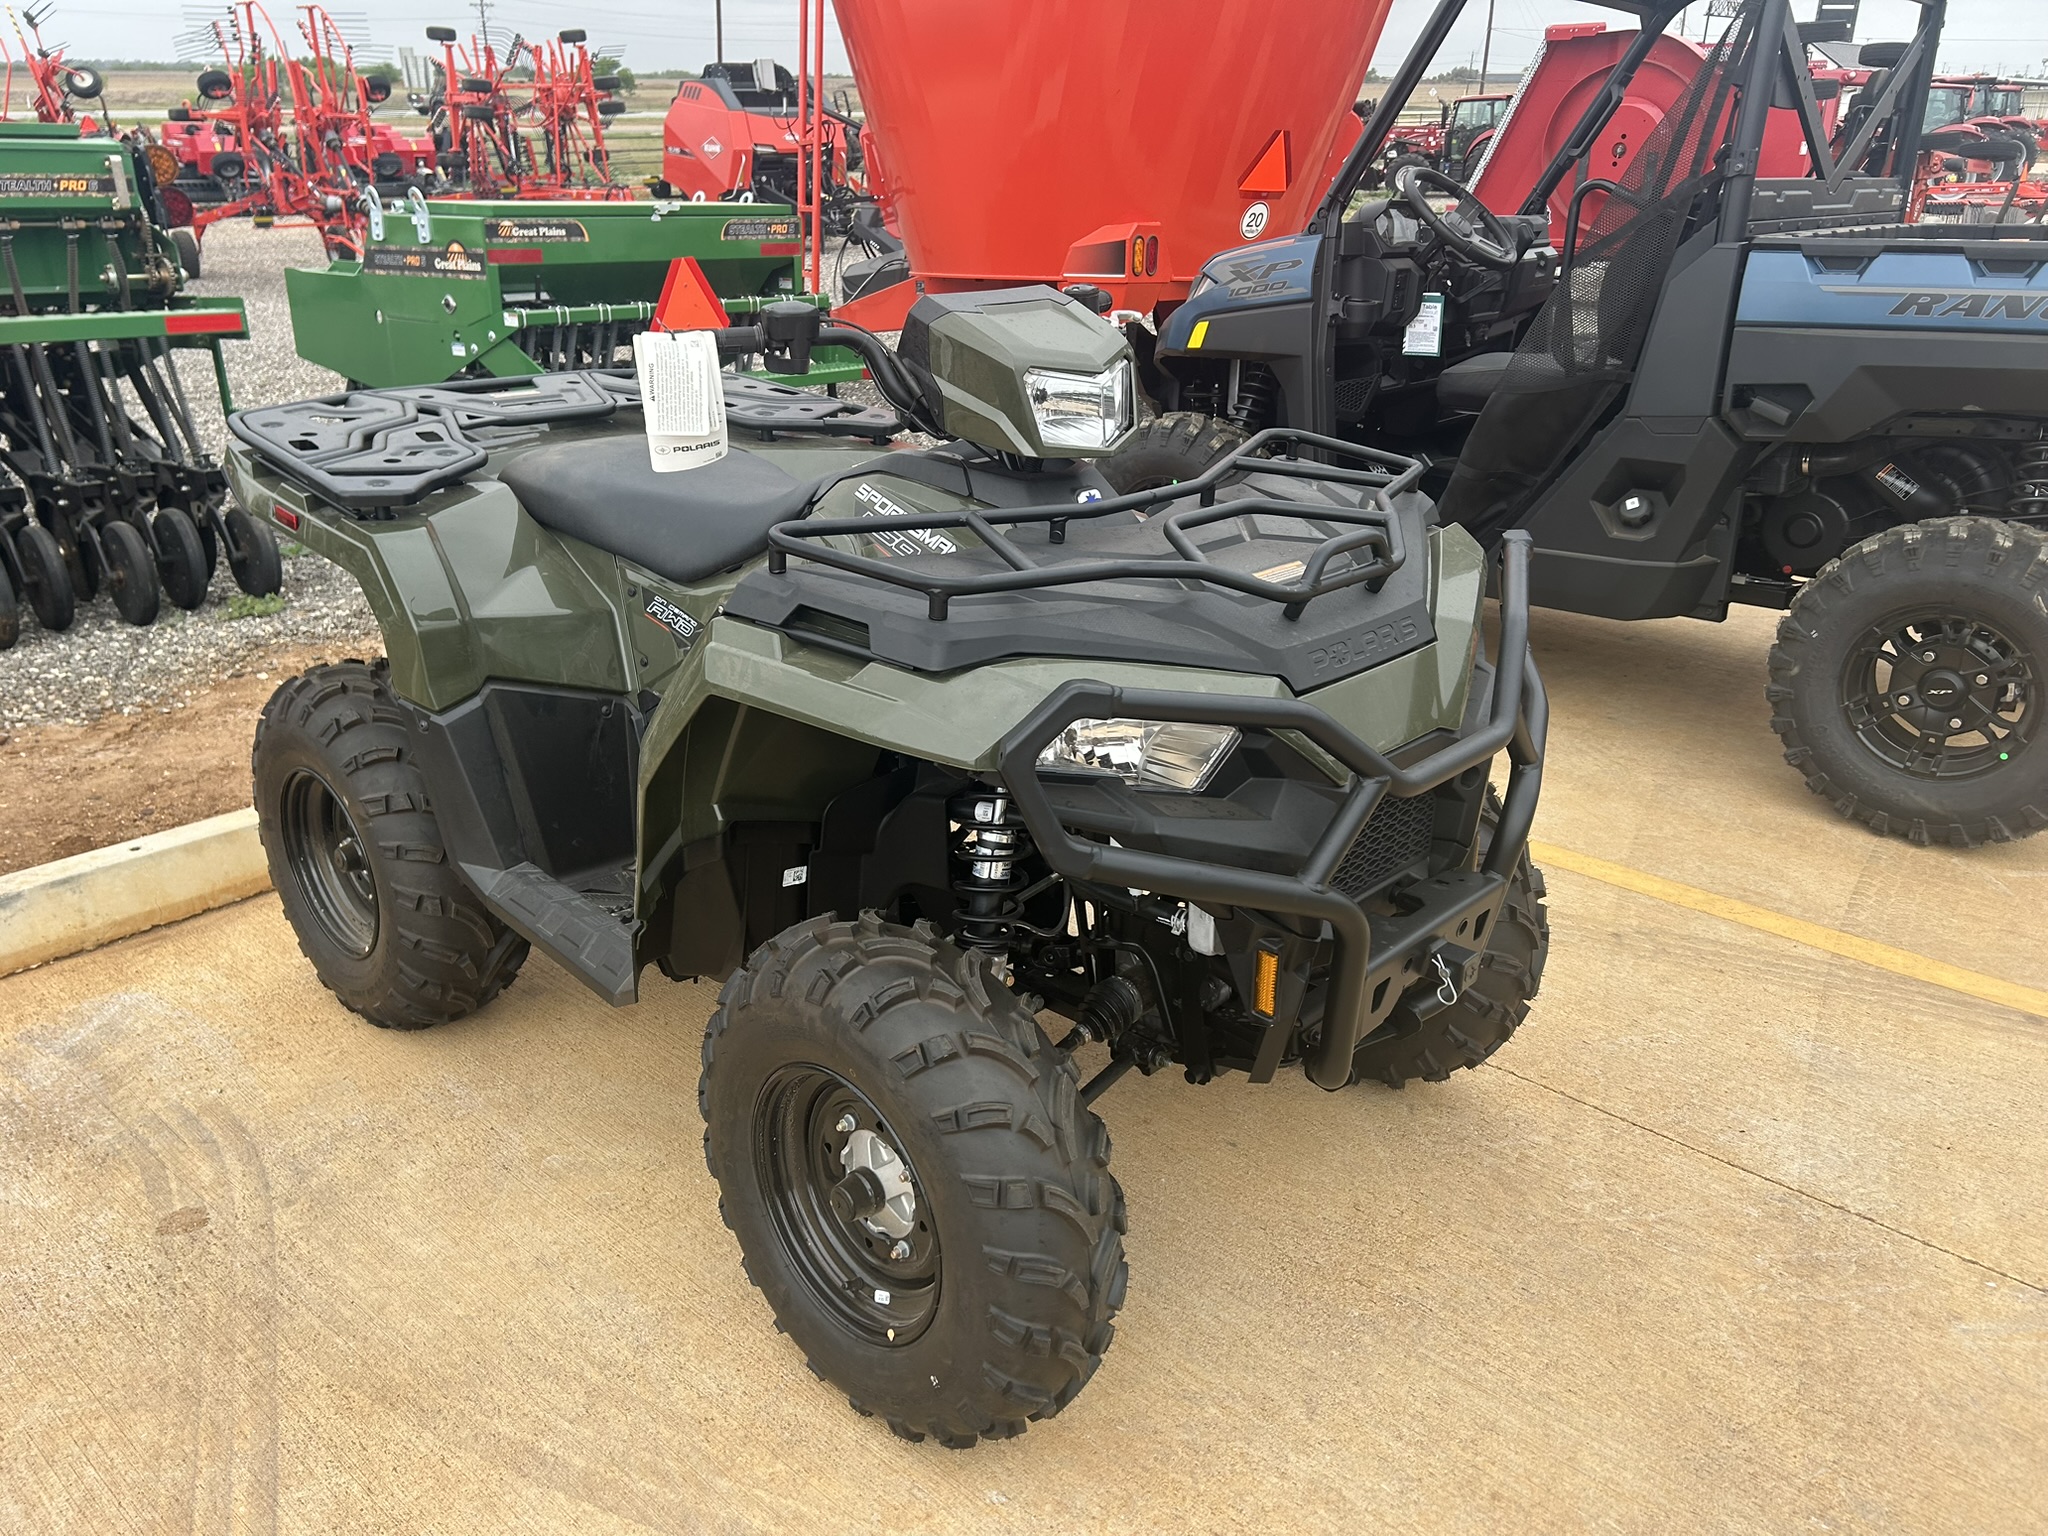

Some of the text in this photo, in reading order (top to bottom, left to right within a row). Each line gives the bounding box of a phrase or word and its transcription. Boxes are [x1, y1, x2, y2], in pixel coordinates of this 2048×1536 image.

[60, 180, 87, 191] PRO
[1246, 212, 1264, 228] 20
[511, 226, 566, 237] Great Plains
[770, 224, 788, 234] PRO
[434, 256, 482, 272] Great Plains
[1219, 259, 1304, 287] XP
[1228, 281, 1288, 297] 1000
[673, 439, 721, 453] POLARIS
[646, 601, 694, 637] AWD
[1307, 616, 1418, 676] POLARIS
